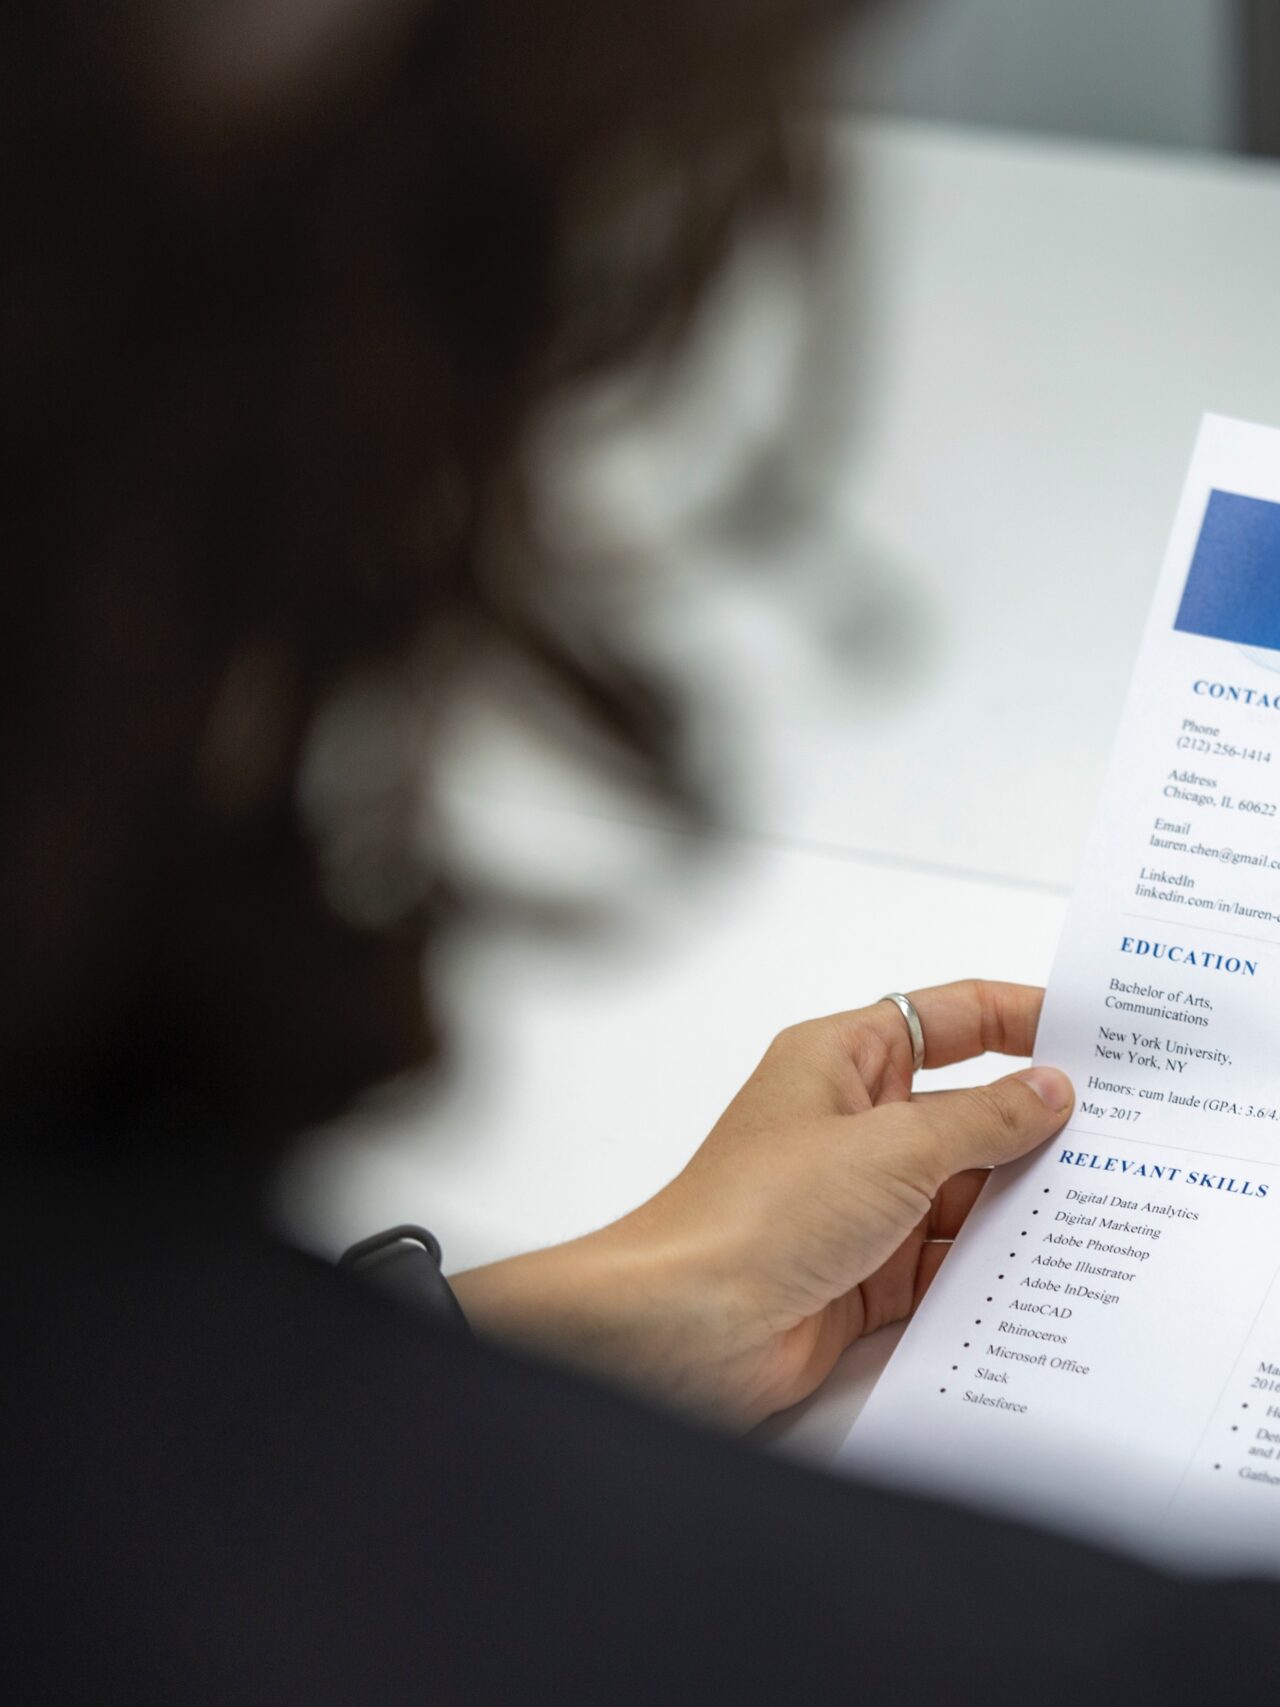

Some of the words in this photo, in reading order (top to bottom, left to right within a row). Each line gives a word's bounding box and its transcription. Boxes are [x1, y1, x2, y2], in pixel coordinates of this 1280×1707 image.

[1181, 718, 1220, 737] Phone
[1175, 735, 1211, 754] (212)
[1212, 741, 1271, 763] 256-1414
[1167, 769, 1217, 787] Address
[1162, 784, 1216, 806] Chicago,
[1220, 795, 1233, 808] IL
[1237, 799, 1277, 816] 60622
[1153, 817, 1191, 835] Email
[1139, 867, 1195, 888] LinkedIn
[1120, 936, 1257, 975] EDUCATION
[1108, 977, 1165, 999] Bachelor
[1166, 990, 1183, 1002] of
[1183, 993, 1212, 1010] Arts,
[1104, 995, 1208, 1026] Communications
[1095, 1044, 1122, 1060] New
[1127, 1050, 1160, 1069] York,
[1165, 1058, 1187, 1072] NY
[1098, 1025, 1126, 1042] New
[1131, 1032, 1161, 1050] York
[1165, 1039, 1231, 1065] University,
[1087, 1075, 1135, 1096] Honors:
[1138, 1089, 1164, 1101] cum
[1167, 1090, 1200, 1107] laude
[1202, 1098, 1242, 1114] (GPA:
[1080, 1101, 1106, 1118] May
[1108, 1106, 1141, 1121] 2017
[1058, 1149, 1181, 1180] RELEVANT
[1185, 1171, 1268, 1196] SKILLS
[1065, 1189, 1108, 1204] Digital
[1109, 1196, 1138, 1210] Data
[1140, 1202, 1199, 1220] Analytics
[1054, 1210, 1097, 1226] Digital
[1098, 1217, 1161, 1239] Marketing
[1042, 1232, 1083, 1247] Adobe
[1085, 1238, 1149, 1261] Photoshop
[1031, 1254, 1072, 1269] Adobe
[1074, 1260, 1136, 1281] Illustrator
[1019, 1276, 1061, 1292] Adobe
[1063, 1283, 1119, 1304] InDesign
[1008, 1299, 1072, 1318] AutoCAD
[997, 1320, 1067, 1344] Rhinoceros
[986, 1343, 1047, 1366] Microsoft
[1049, 1357, 1090, 1374] Office
[974, 1367, 1007, 1384] Slack
[962, 1390, 1027, 1413] Salesforce
